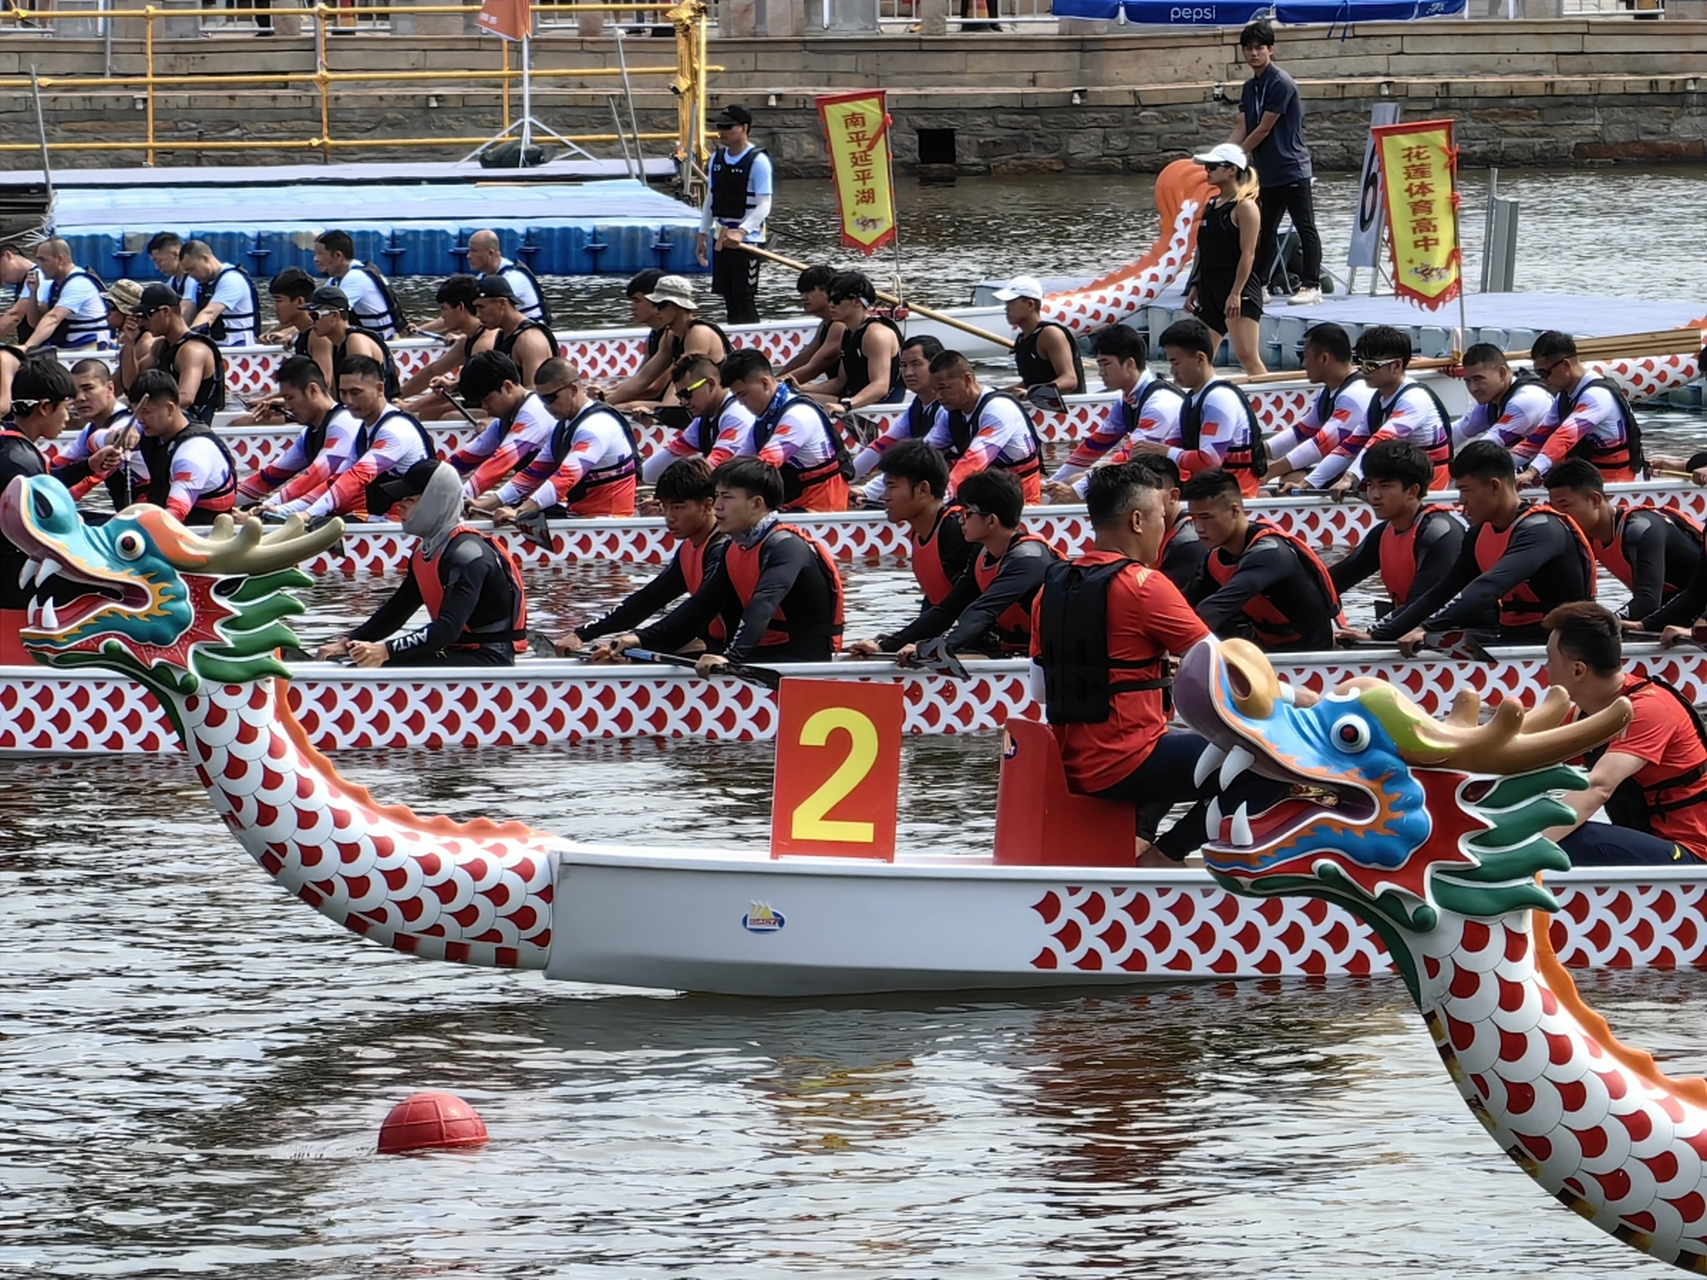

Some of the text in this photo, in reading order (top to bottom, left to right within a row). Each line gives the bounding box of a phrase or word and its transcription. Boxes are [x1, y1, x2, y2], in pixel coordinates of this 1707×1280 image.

[1170, 5, 1216, 22] pepsi
[842, 112, 875, 206] 南平延平湖
[1360, 142, 1378, 232] 6
[1401, 145, 1440, 252] 花莲体育高中
[791, 707, 878, 843] 2
